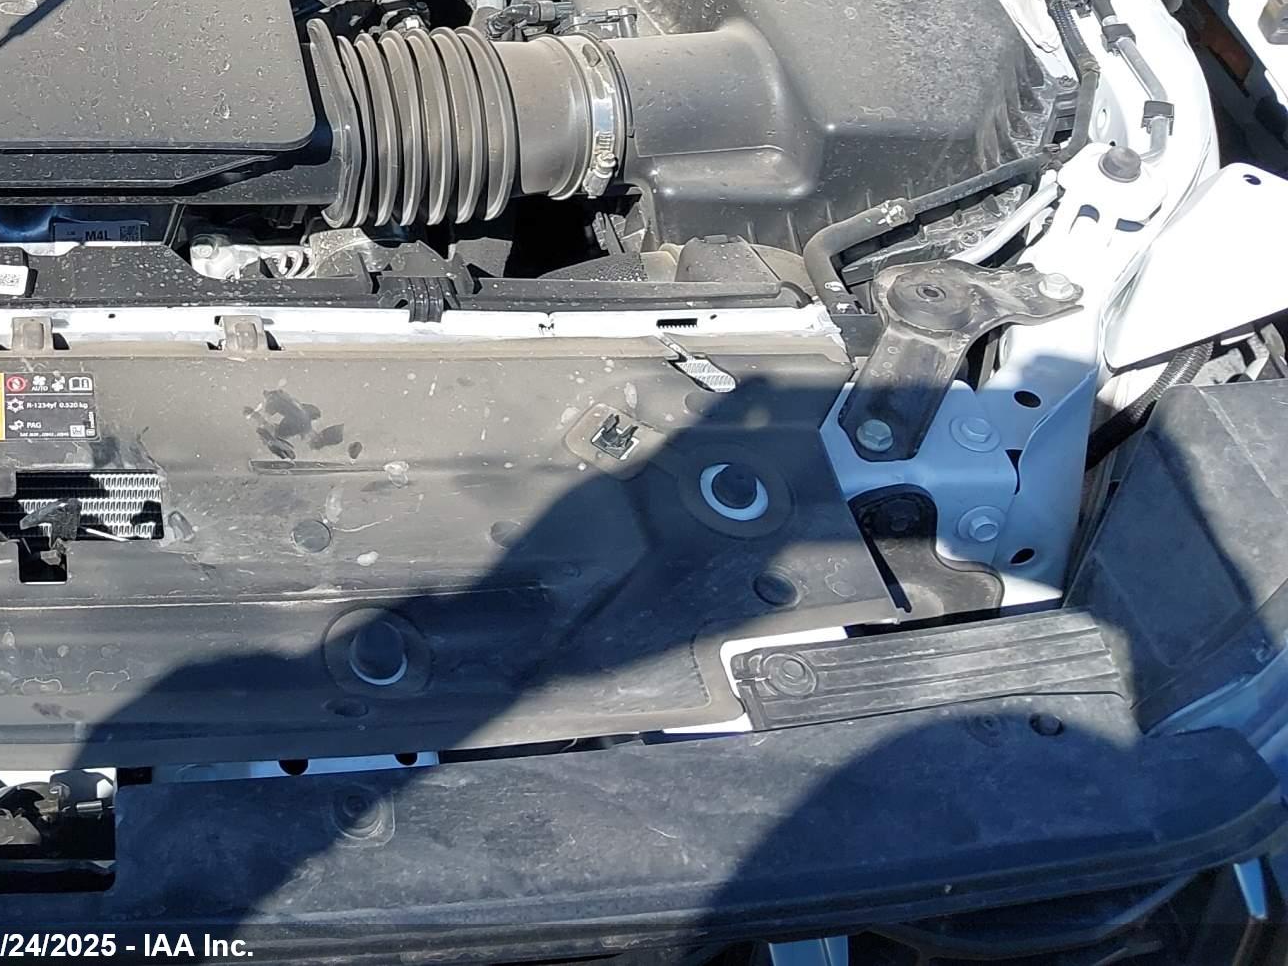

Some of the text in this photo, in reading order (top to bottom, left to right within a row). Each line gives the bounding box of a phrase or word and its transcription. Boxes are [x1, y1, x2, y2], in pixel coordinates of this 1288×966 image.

[85, 230, 112, 241] M4L
[26, 401, 57, 409] R-1234yf
[79, 401, 89, 409] kg
[26, 421, 42, 429] PAG
